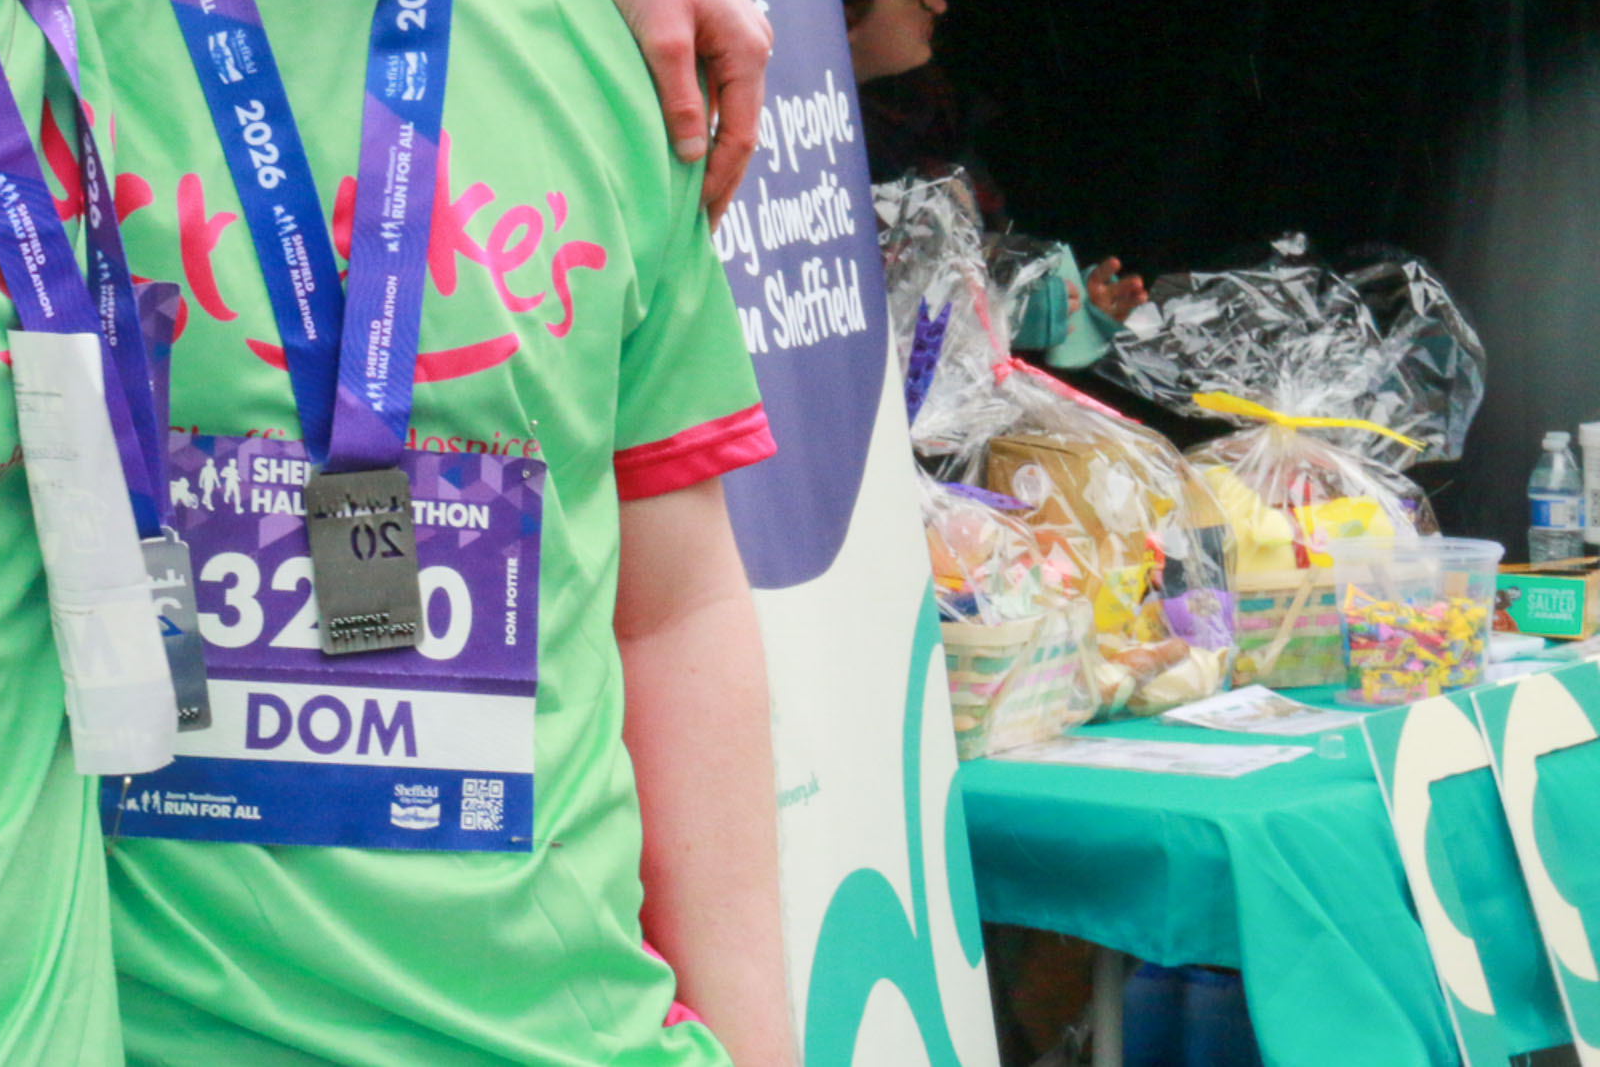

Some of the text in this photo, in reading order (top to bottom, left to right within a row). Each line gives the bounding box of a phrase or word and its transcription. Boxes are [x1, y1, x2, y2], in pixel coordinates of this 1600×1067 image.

[234, 99, 287, 189] 2026
[776, 69, 855, 173] people
[83, 133, 102, 229] 2026
[391, 121, 415, 219] RUN FOR ALL
[758, 171, 856, 251] domestic
[6, 207, 55, 319] HALF MARATHON
[16, 202, 47, 266] SHEFFIELD
[291, 233, 316, 293] SHEFFIELD
[280, 237, 317, 341] HALF MARATHON
[377, 275, 398, 380] HALF MARATHON
[764, 256, 867, 350] Sheffield
[365, 320, 382, 378] SHEFFIELD
[251, 489, 490, 530] HAL THON
[198, 551, 473, 661] 320
[504, 558, 519, 645] DOM POTTER
[1527, 593, 1576, 615] SALTED
[245, 692, 418, 758] DOM
[163, 801, 262, 820] RUN FOR ALL
[394, 784, 439, 798] Sheffield
